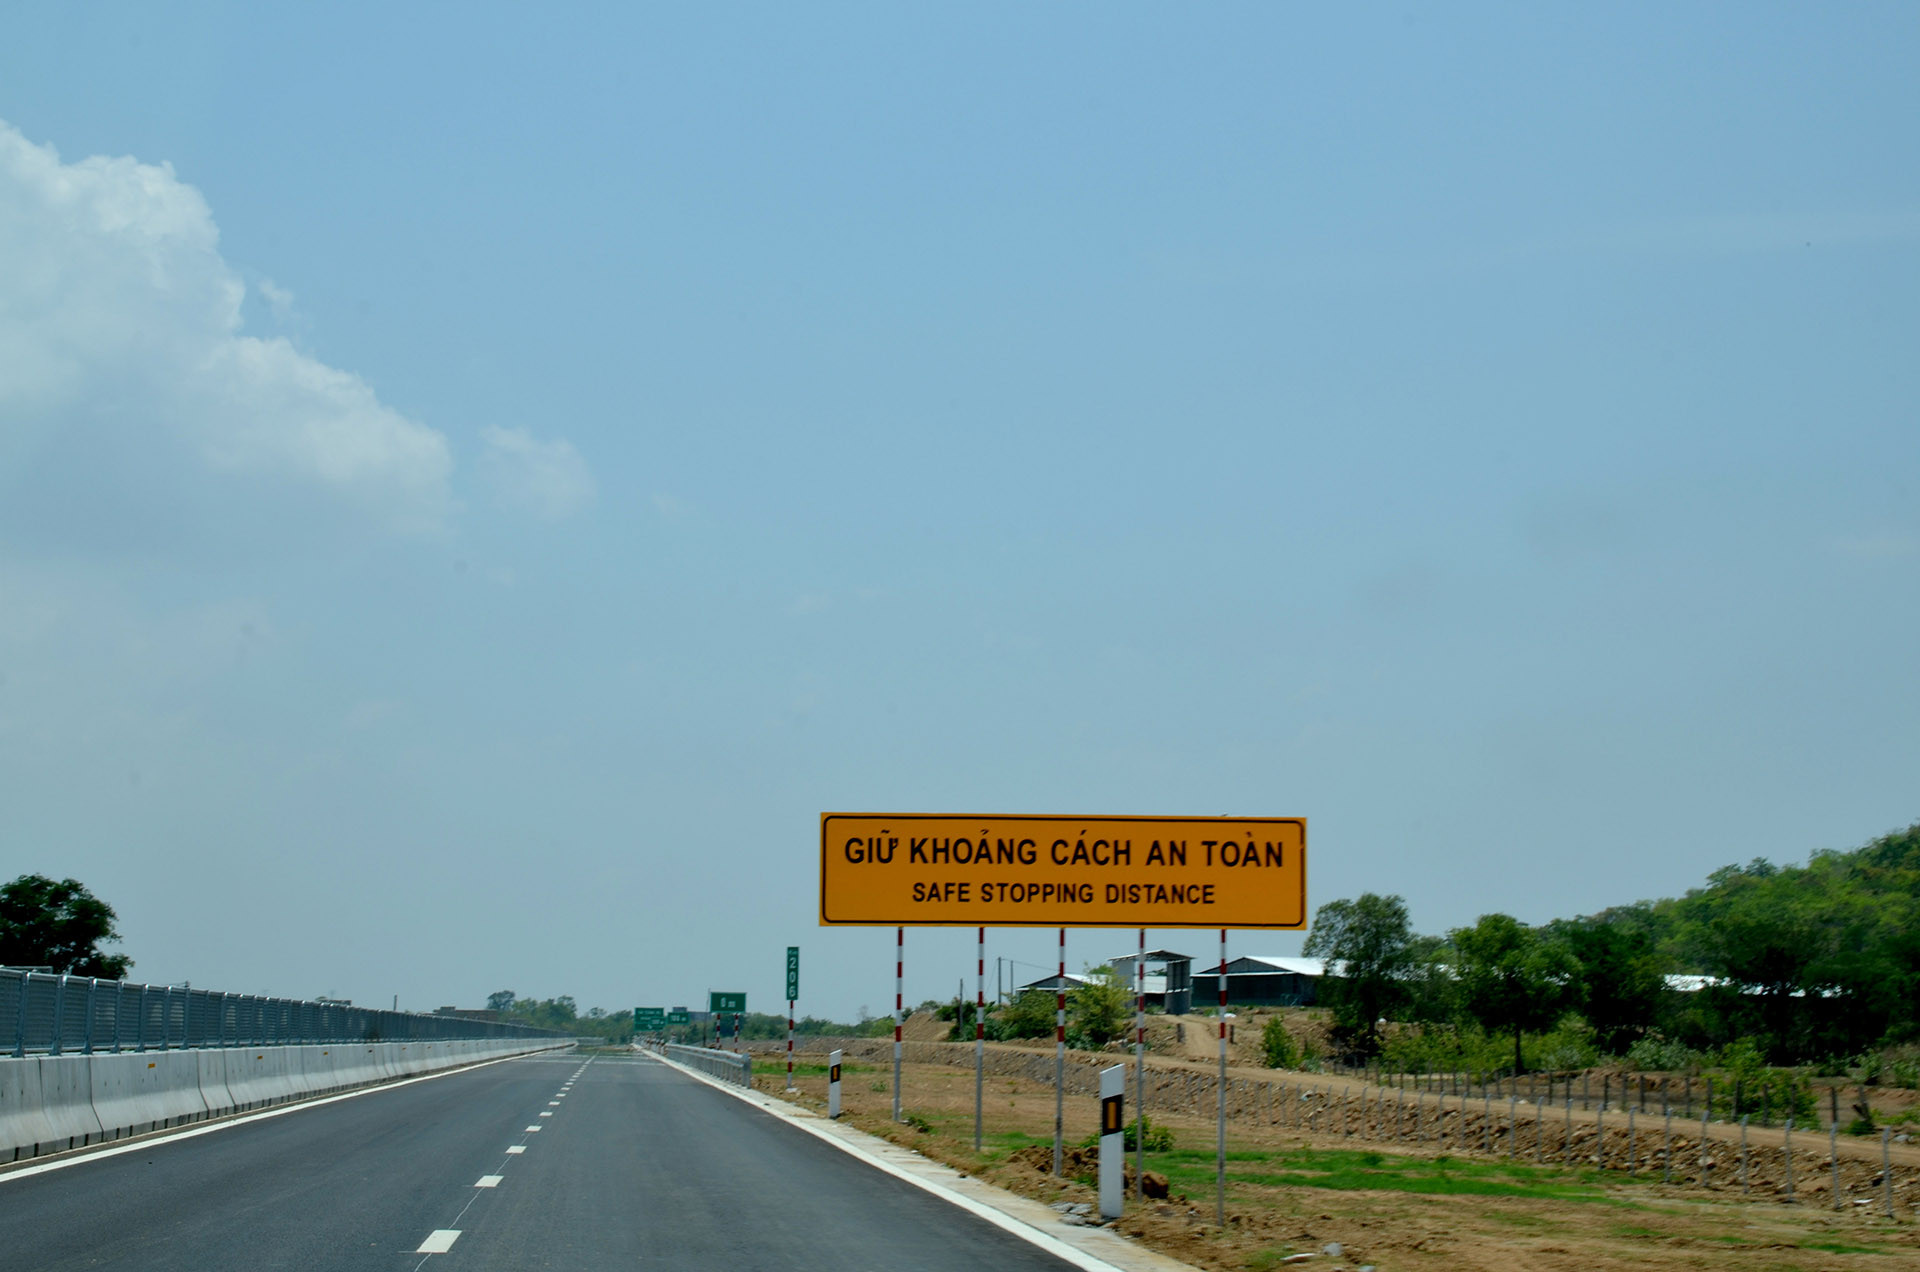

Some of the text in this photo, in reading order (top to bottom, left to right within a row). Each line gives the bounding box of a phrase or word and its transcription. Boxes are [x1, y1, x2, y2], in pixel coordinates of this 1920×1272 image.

[844, 828, 1283, 867] GIỮ KHOẢNG CÁCH AN TOÀN
[912, 882, 1216, 904] SAFE STOPPING DISTANCE
[788, 957, 797, 998] 206
